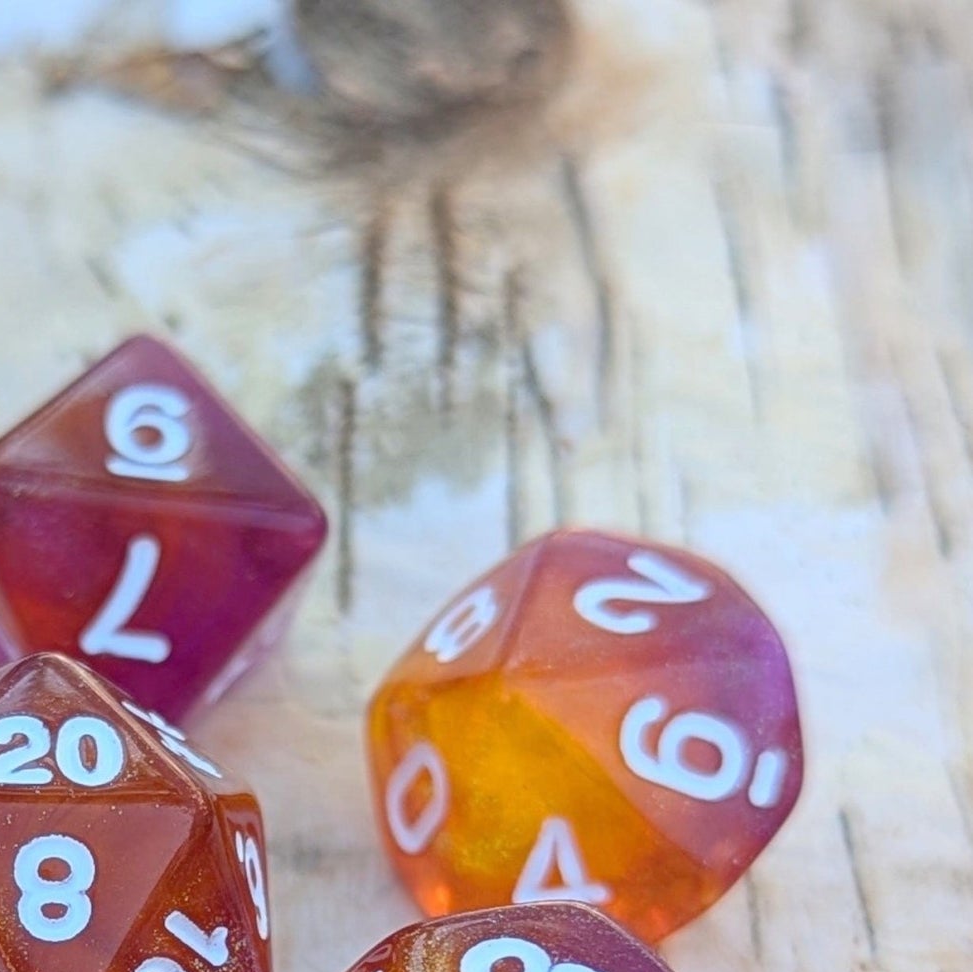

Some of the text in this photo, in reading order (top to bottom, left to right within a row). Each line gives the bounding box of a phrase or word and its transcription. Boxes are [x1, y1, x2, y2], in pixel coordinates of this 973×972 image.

[106, 386, 192, 481] 6
[81, 537, 169, 662] 7
[573, 550, 711, 635] 2
[386, 741, 448, 853] 0
[620, 697, 783, 806] 6
[14, 834, 95, 942] 8
[513, 816, 611, 903] 4
